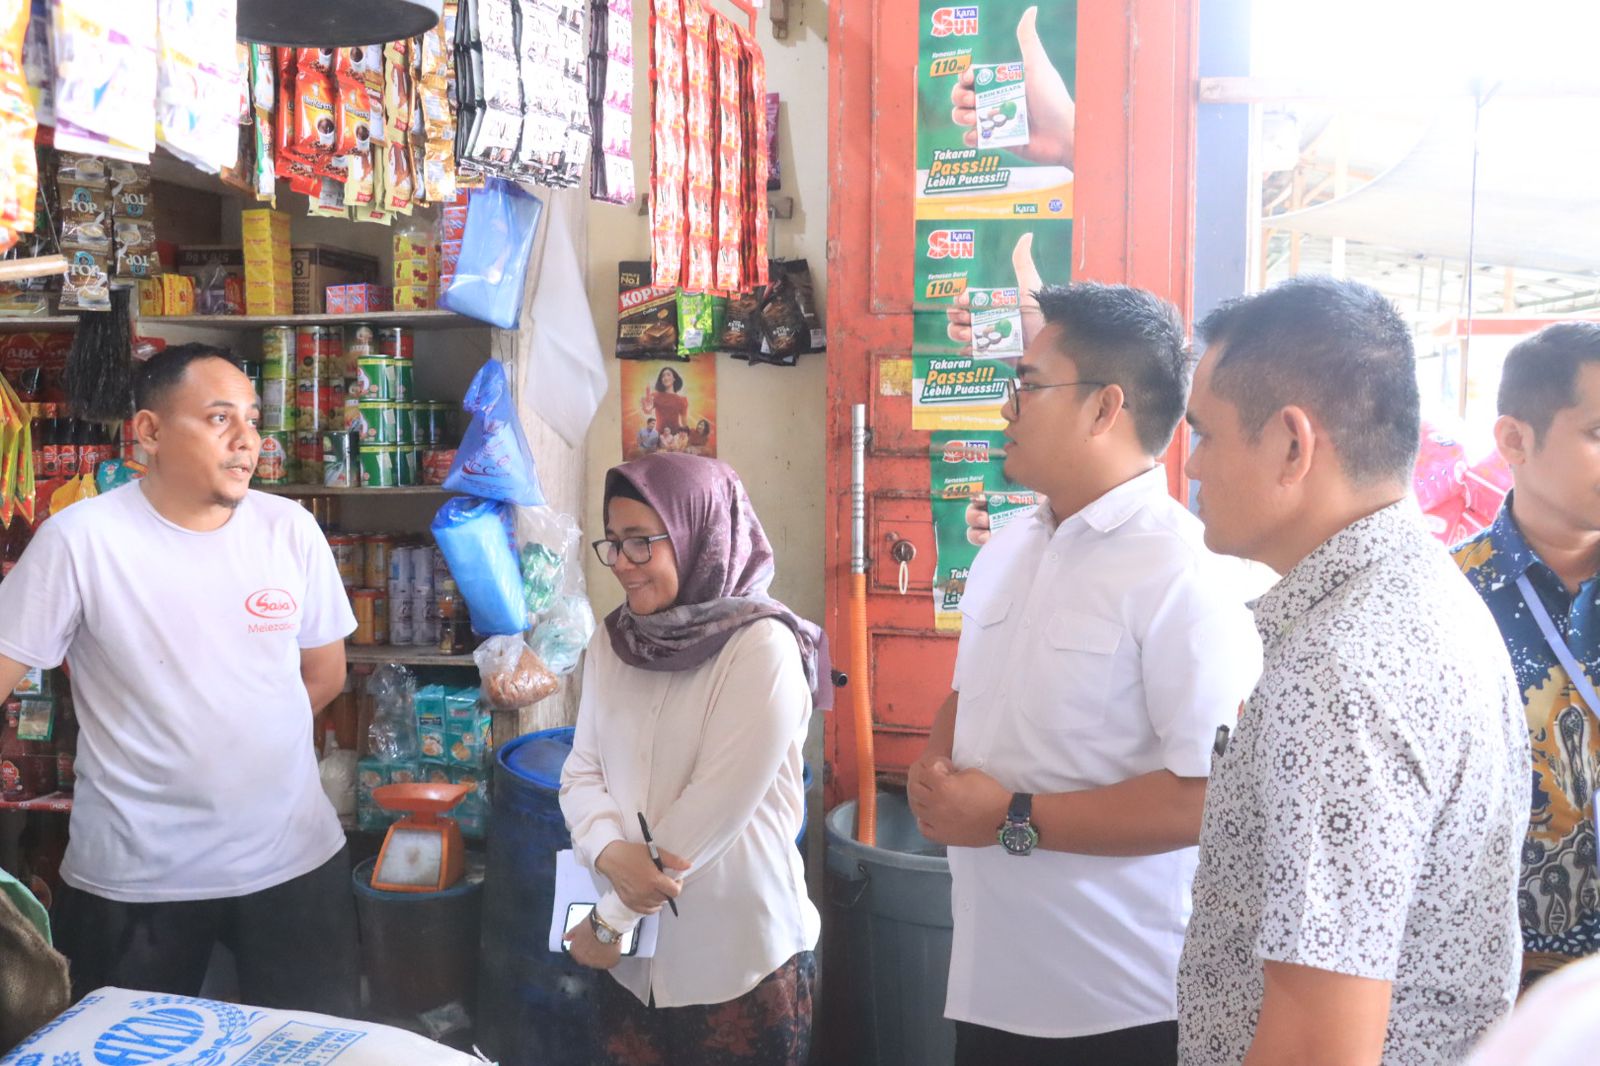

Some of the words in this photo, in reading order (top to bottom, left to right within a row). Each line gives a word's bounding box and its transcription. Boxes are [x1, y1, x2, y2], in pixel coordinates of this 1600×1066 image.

[955, 8, 977, 19] kara
[931, 8, 978, 36] SUN
[934, 59, 957, 74] 110
[995, 64, 1023, 82] SUN
[933, 149, 976, 160] Takaran
[930, 157, 999, 177] Passs!!!
[927, 175, 956, 188] Lebih
[958, 171, 1009, 186] Puasss!!!
[68, 199, 97, 214] TOP
[121, 193, 148, 206] TOP
[1015, 204, 1038, 214] kara
[952, 231, 974, 243] kara
[927, 230, 974, 259] SUN
[126, 255, 150, 267] TOP
[68, 264, 100, 276] TOP
[930, 282, 954, 296] 110
[929, 359, 972, 370] Takaran
[926, 367, 995, 386] Passs!!!
[923, 384, 952, 397] Lebih
[953, 381, 1005, 395] Puasss!!!
